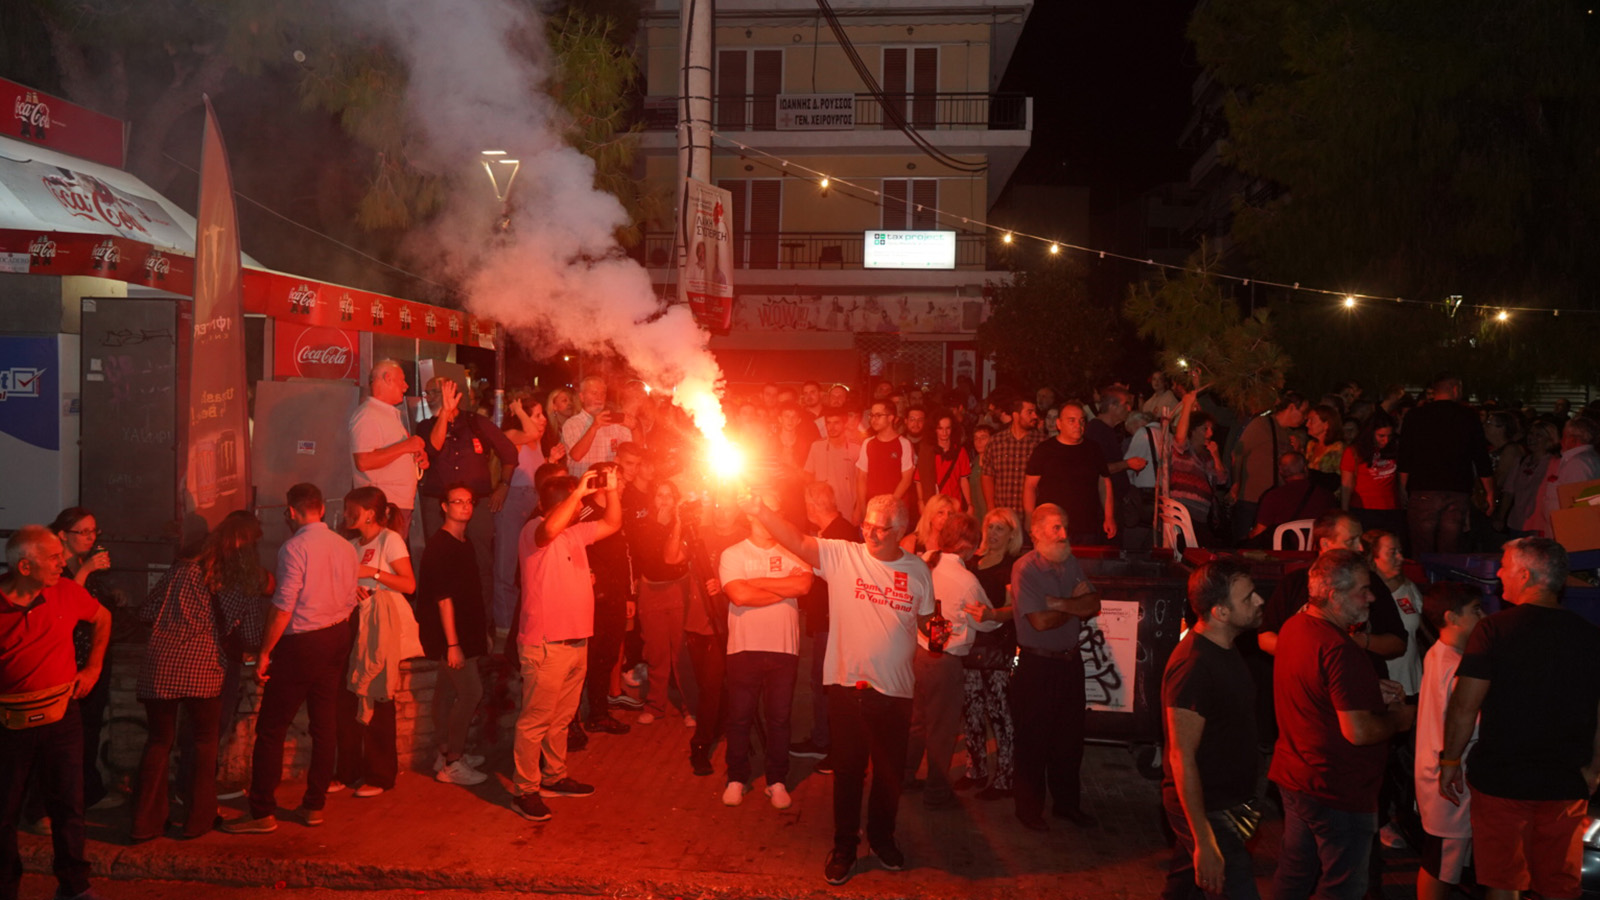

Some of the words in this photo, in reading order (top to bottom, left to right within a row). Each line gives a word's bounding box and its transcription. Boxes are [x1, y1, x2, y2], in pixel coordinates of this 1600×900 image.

[780, 98, 812, 110] ΙΩΑΝΝΗΣ
[821, 97, 853, 110] ΡΟΥΣΣΟΣ
[794, 114, 810, 125] ΓΕΝ.
[811, 114, 853, 125] ΧΕΙΡΟΥΡΓΟΣ
[887, 233, 904, 241] tax
[904, 232, 944, 242] project
[856, 577, 881, 592] Com
[855, 590, 865, 600] To
[889, 600, 913, 612] Land
